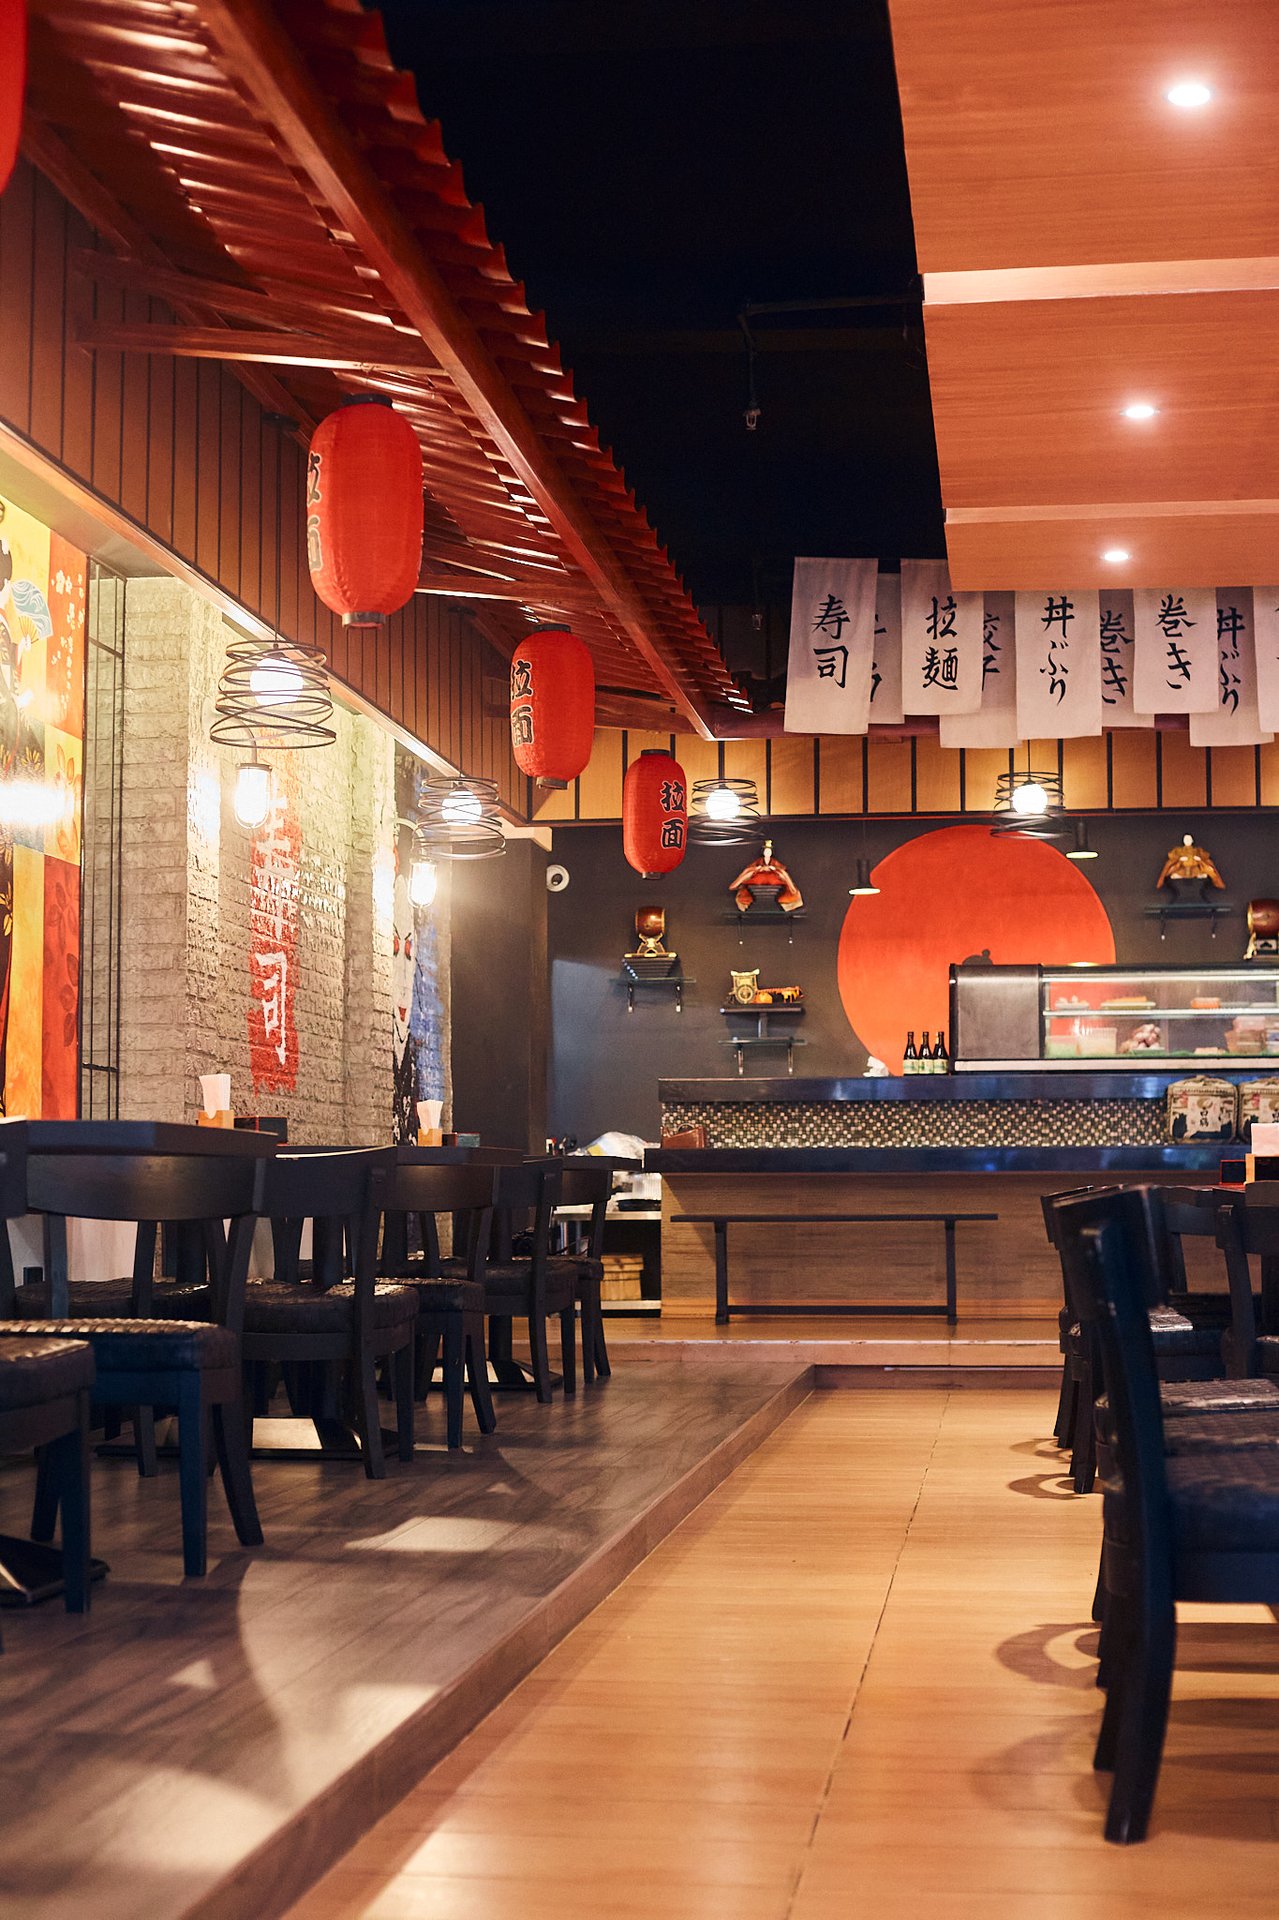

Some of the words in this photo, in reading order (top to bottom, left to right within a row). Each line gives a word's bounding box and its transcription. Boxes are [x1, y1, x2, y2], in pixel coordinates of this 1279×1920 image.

[812, 594, 850, 689] 寿司
[1039, 596, 1076, 706] 丼ぶり
[1100, 610, 1134, 704] 巻き
[1155, 594, 1197, 690] 巻き
[660, 780, 686, 849] 拉面
